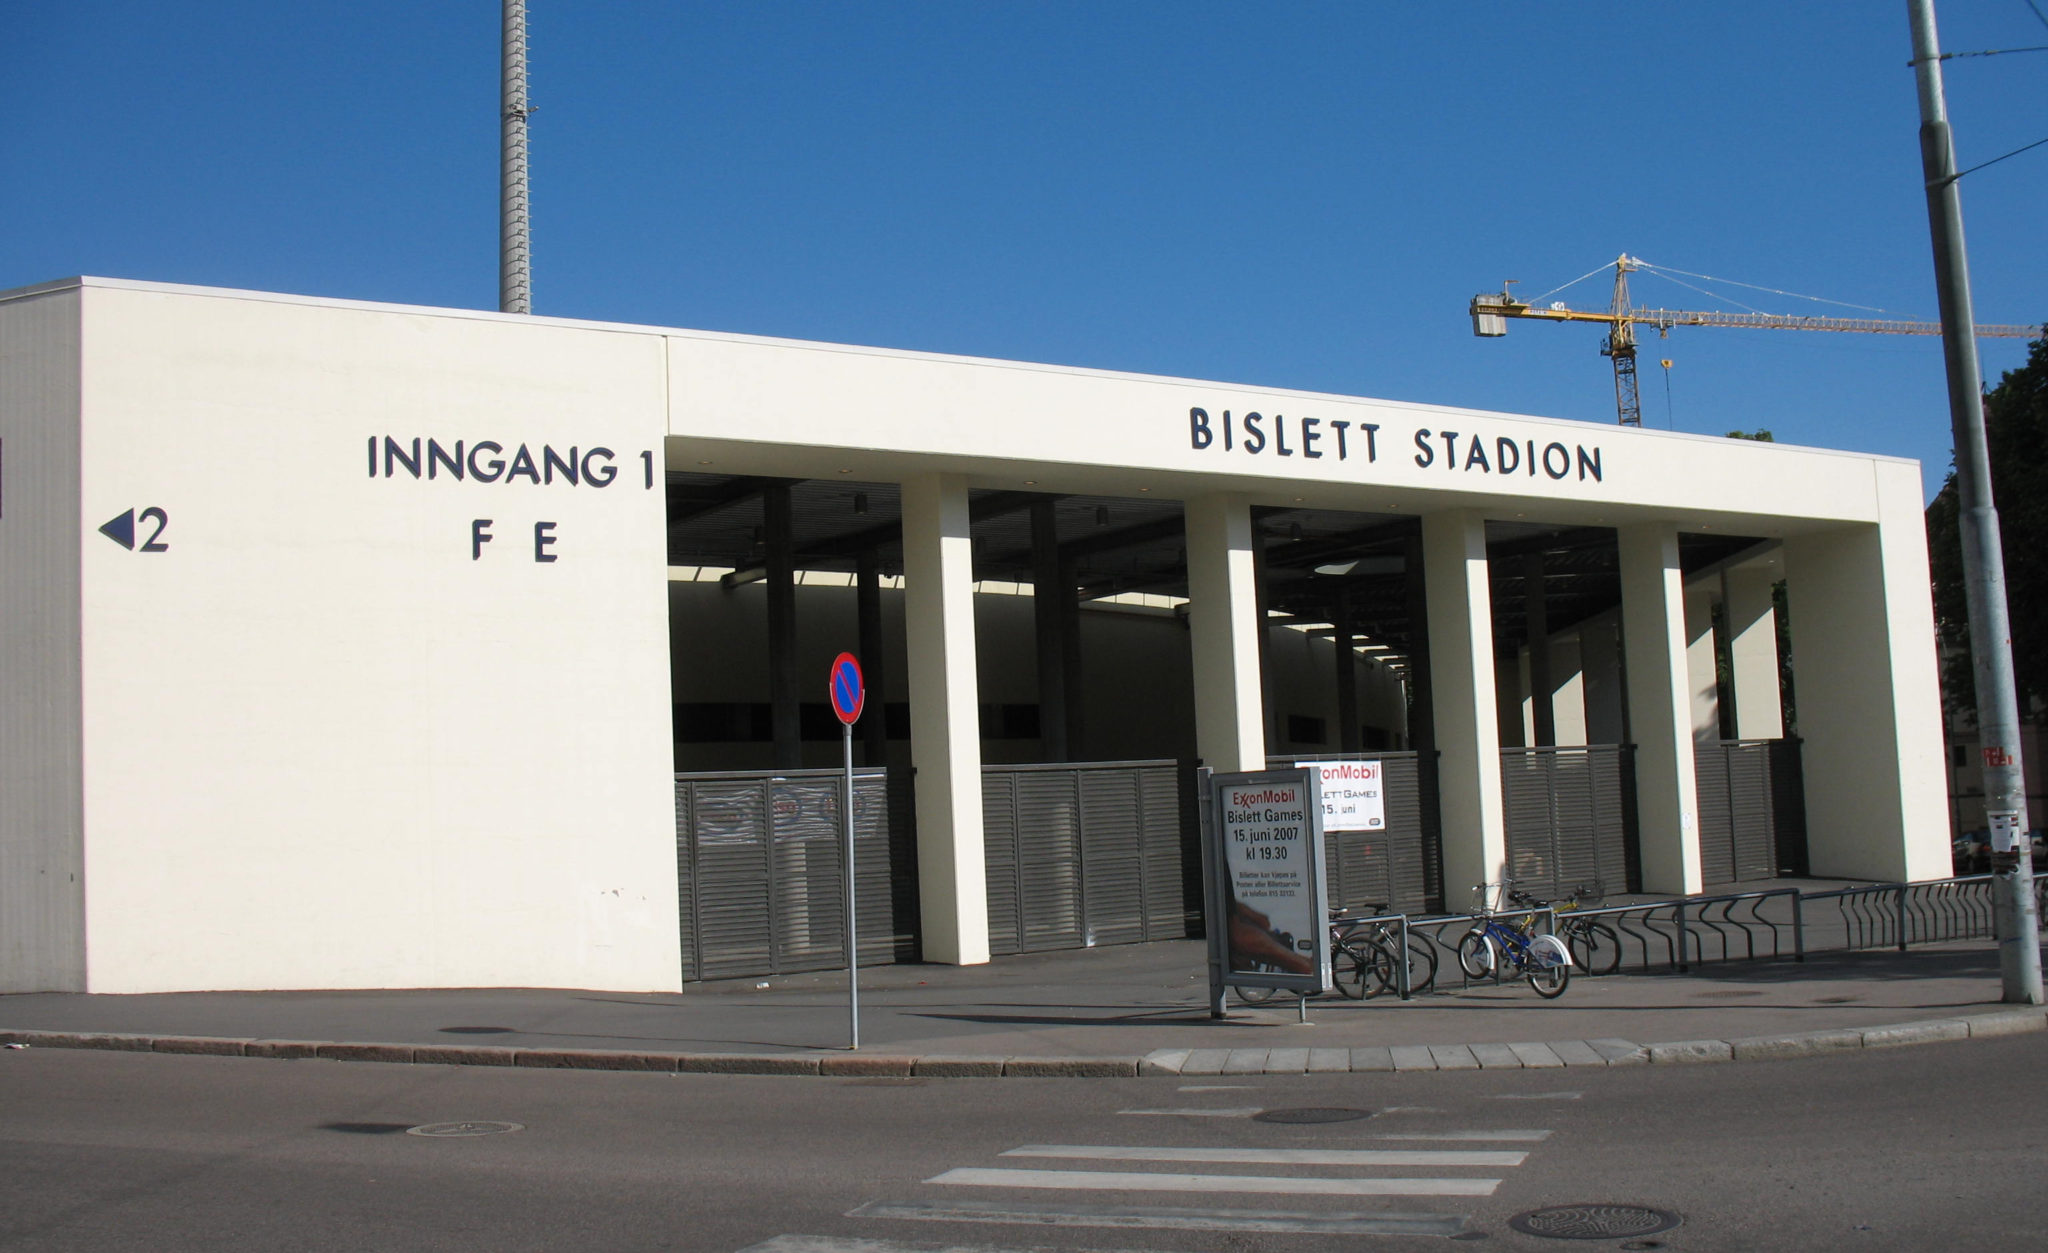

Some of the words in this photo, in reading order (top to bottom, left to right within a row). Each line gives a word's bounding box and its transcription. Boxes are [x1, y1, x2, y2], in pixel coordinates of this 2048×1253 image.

[1190, 408, 1379, 462] BISLETT
[1415, 429, 1602, 482] STADION
[368, 436, 617, 488] INNGANG
[640, 450, 653, 489] 1
[138, 507, 168, 552] 2
[471, 520, 493, 560] F
[534, 522, 557, 562] E
[1320, 764, 1379, 784] onMobil
[1233, 789, 1295, 809] ExxonMobil
[1228, 810, 1261, 824] Bislett
[1264, 808, 1303, 822] Games
[1234, 829, 1248, 842] 15.
[1249, 828, 1271, 844] juni
[1273, 827, 1298, 841] 2007
[1246, 847, 1256, 860] kl
[1259, 846, 1288, 860] 19.30
